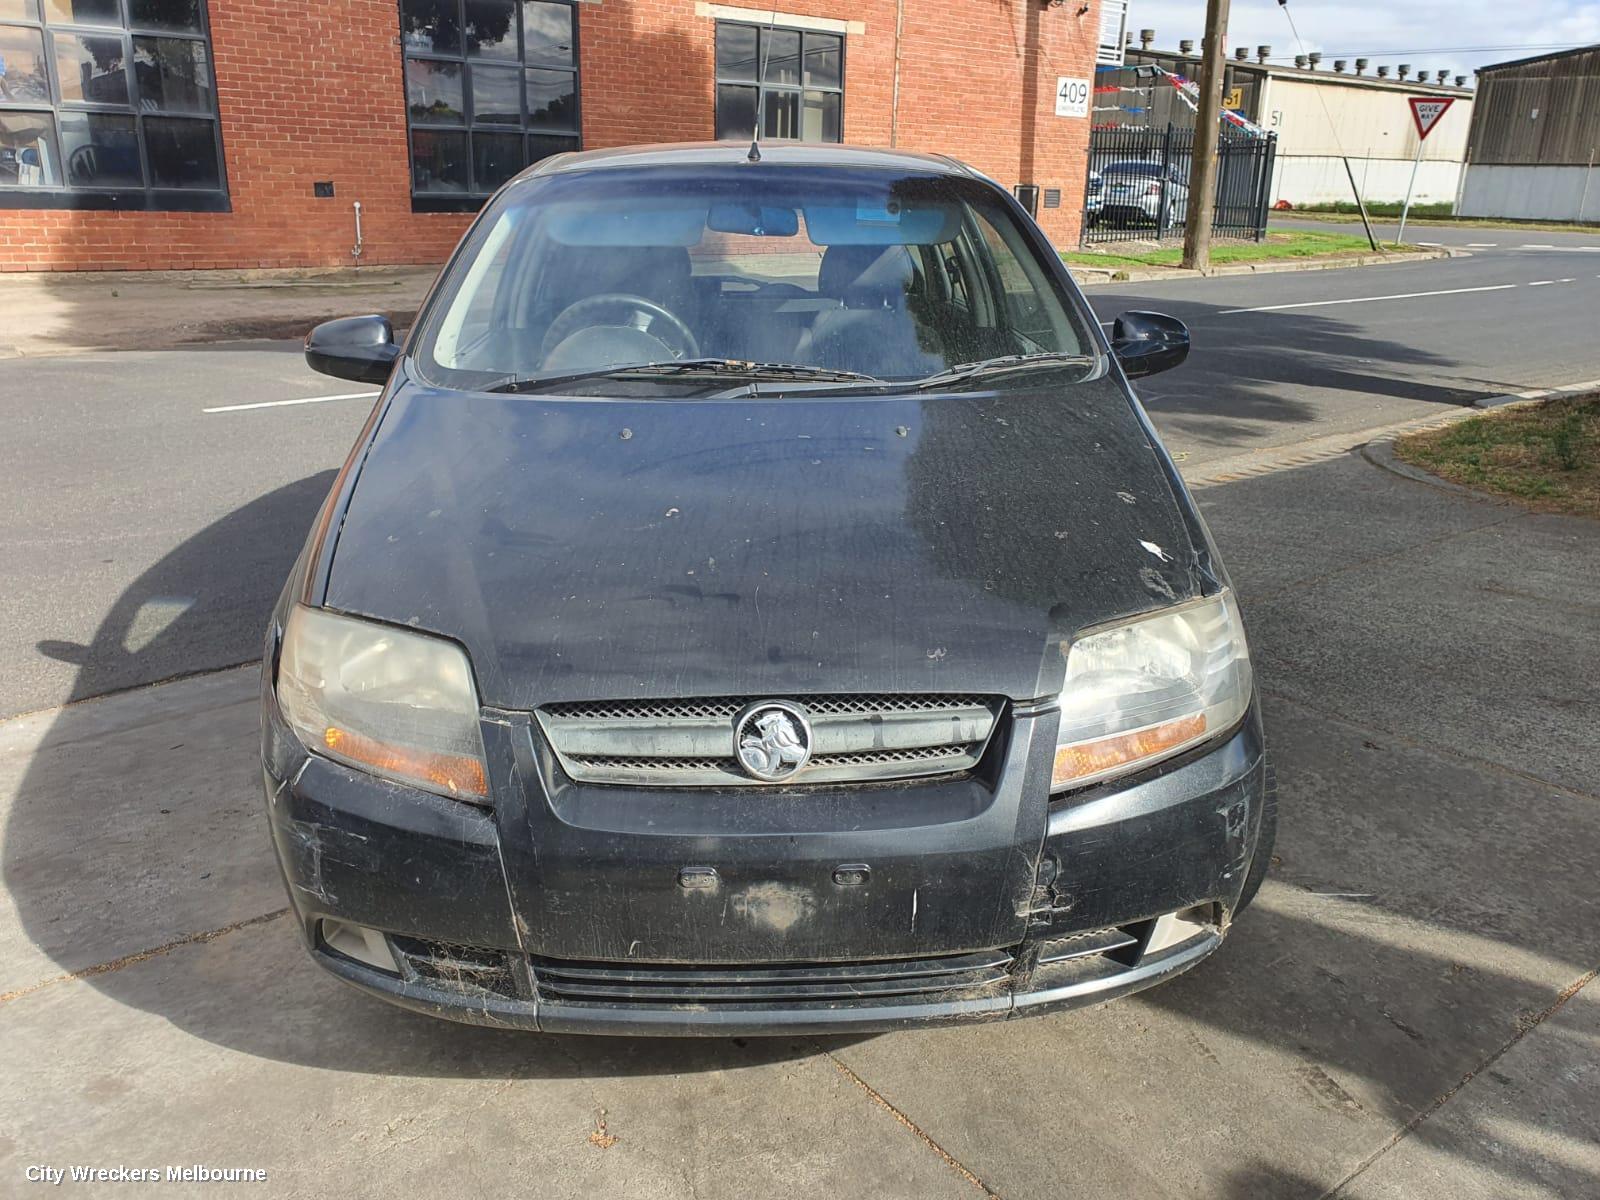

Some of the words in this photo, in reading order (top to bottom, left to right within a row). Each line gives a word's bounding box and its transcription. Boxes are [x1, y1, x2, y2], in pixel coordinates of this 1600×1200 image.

[1059, 82, 1087, 104] 409
[1418, 104, 1440, 113] GIVE
[1271, 110, 1283, 126] 51
